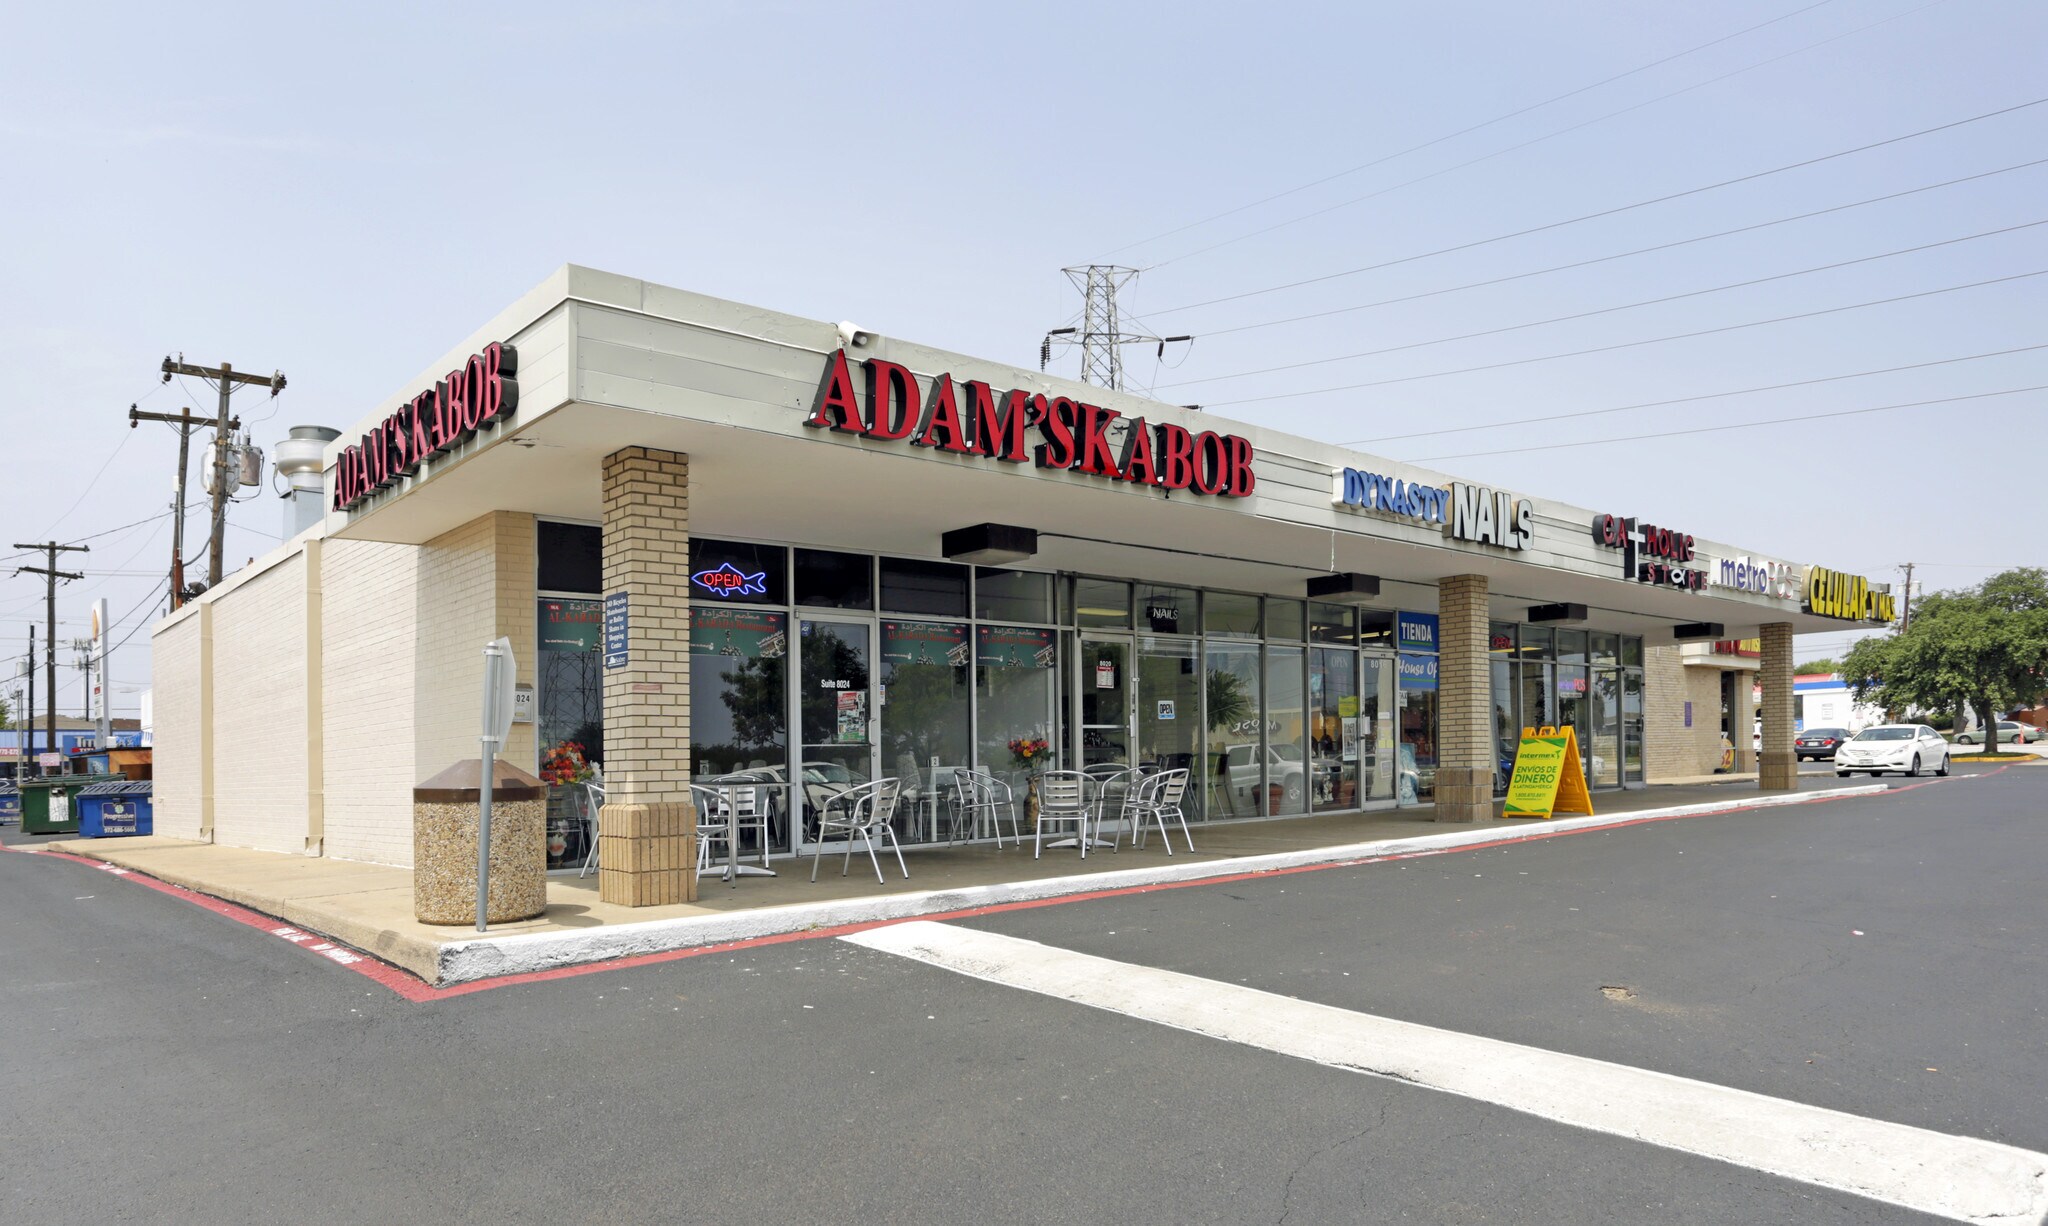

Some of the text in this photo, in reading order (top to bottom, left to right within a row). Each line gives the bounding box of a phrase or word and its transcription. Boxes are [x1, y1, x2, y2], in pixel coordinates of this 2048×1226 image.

[1343, 467, 1450, 524] DYNASTY
[1452, 481, 1534, 551] NAILS
[703, 573, 742, 587] OPEN
[1808, 564, 1868, 621] CELULAR
[1153, 607, 1179, 620] NAILS
[1401, 622, 1433, 642] TIENDA
[821, 679, 850, 689] Suite 8024
[516, 694, 530, 703] 024
[1160, 703, 1173, 714] OPEN
[1516, 765, 1558, 774] ENVÍOS DE
[1514, 774, 1555, 783] DINERO
